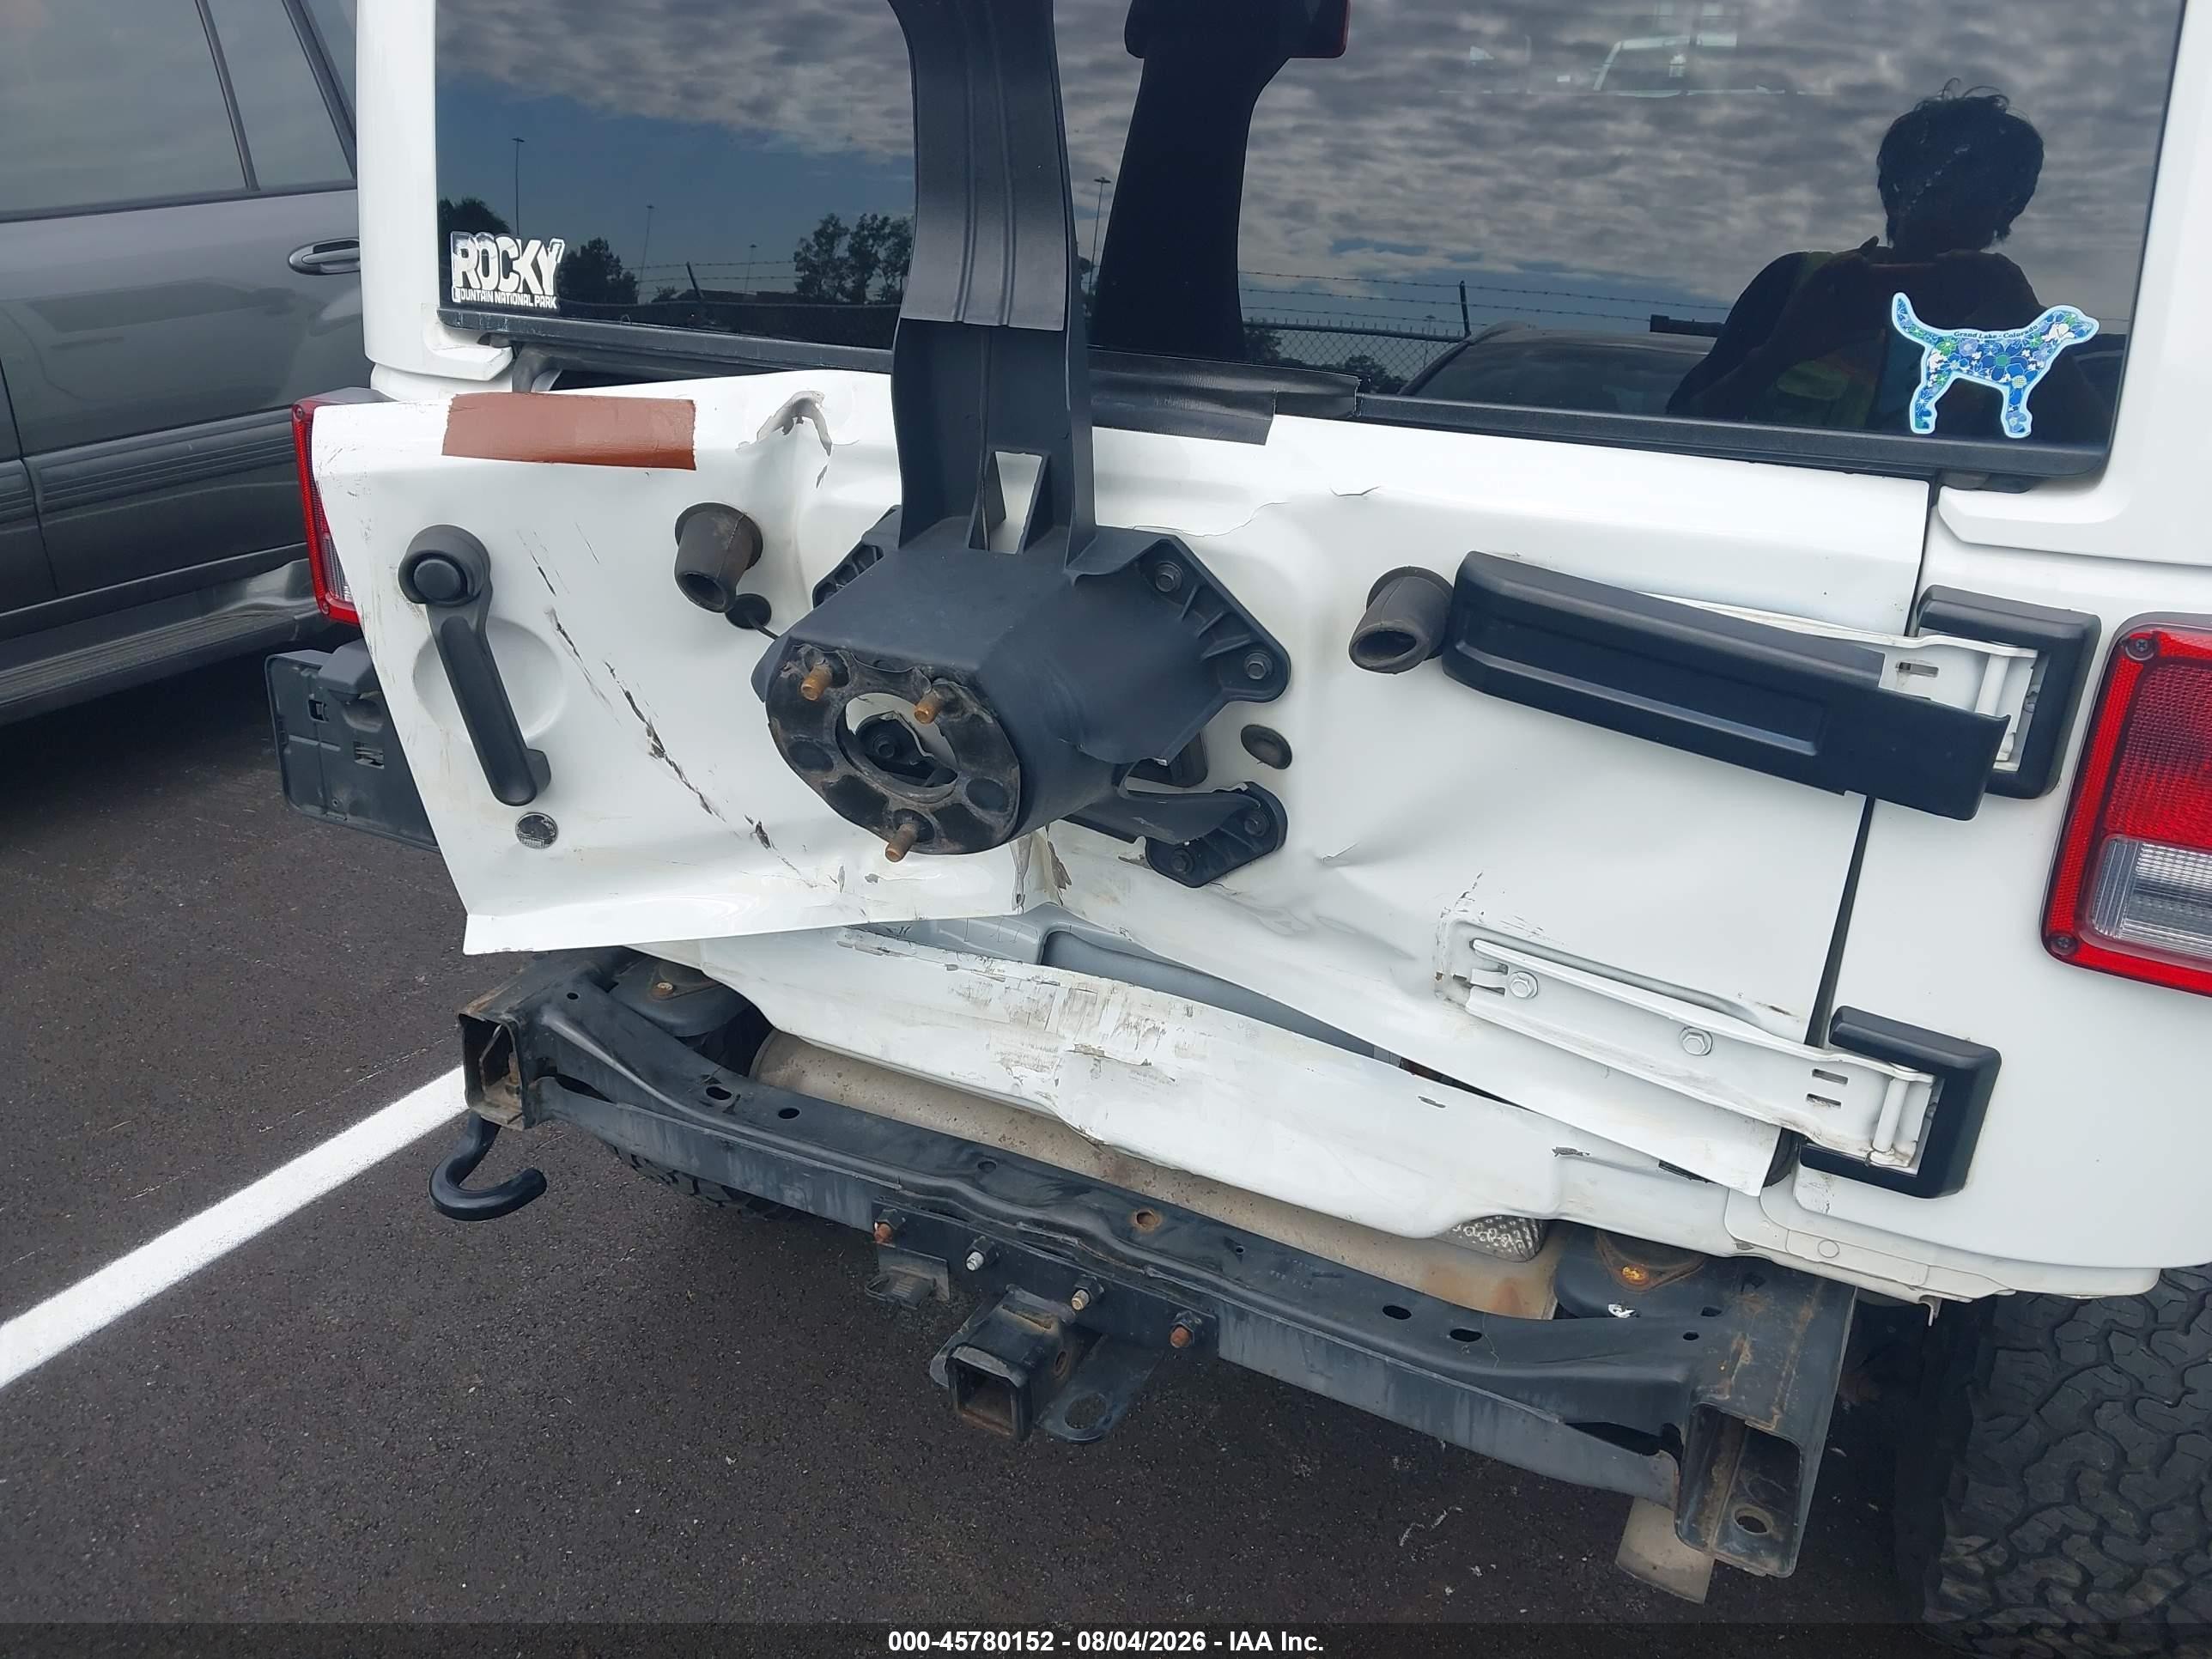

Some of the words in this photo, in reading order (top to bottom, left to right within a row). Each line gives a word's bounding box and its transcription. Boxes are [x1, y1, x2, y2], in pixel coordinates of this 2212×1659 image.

[451, 232, 564, 295] ROCKY
[495, 292, 533, 306] NATIONAL
[534, 295, 557, 309] PARK
[2002, 325, 2039, 338] Colorado
